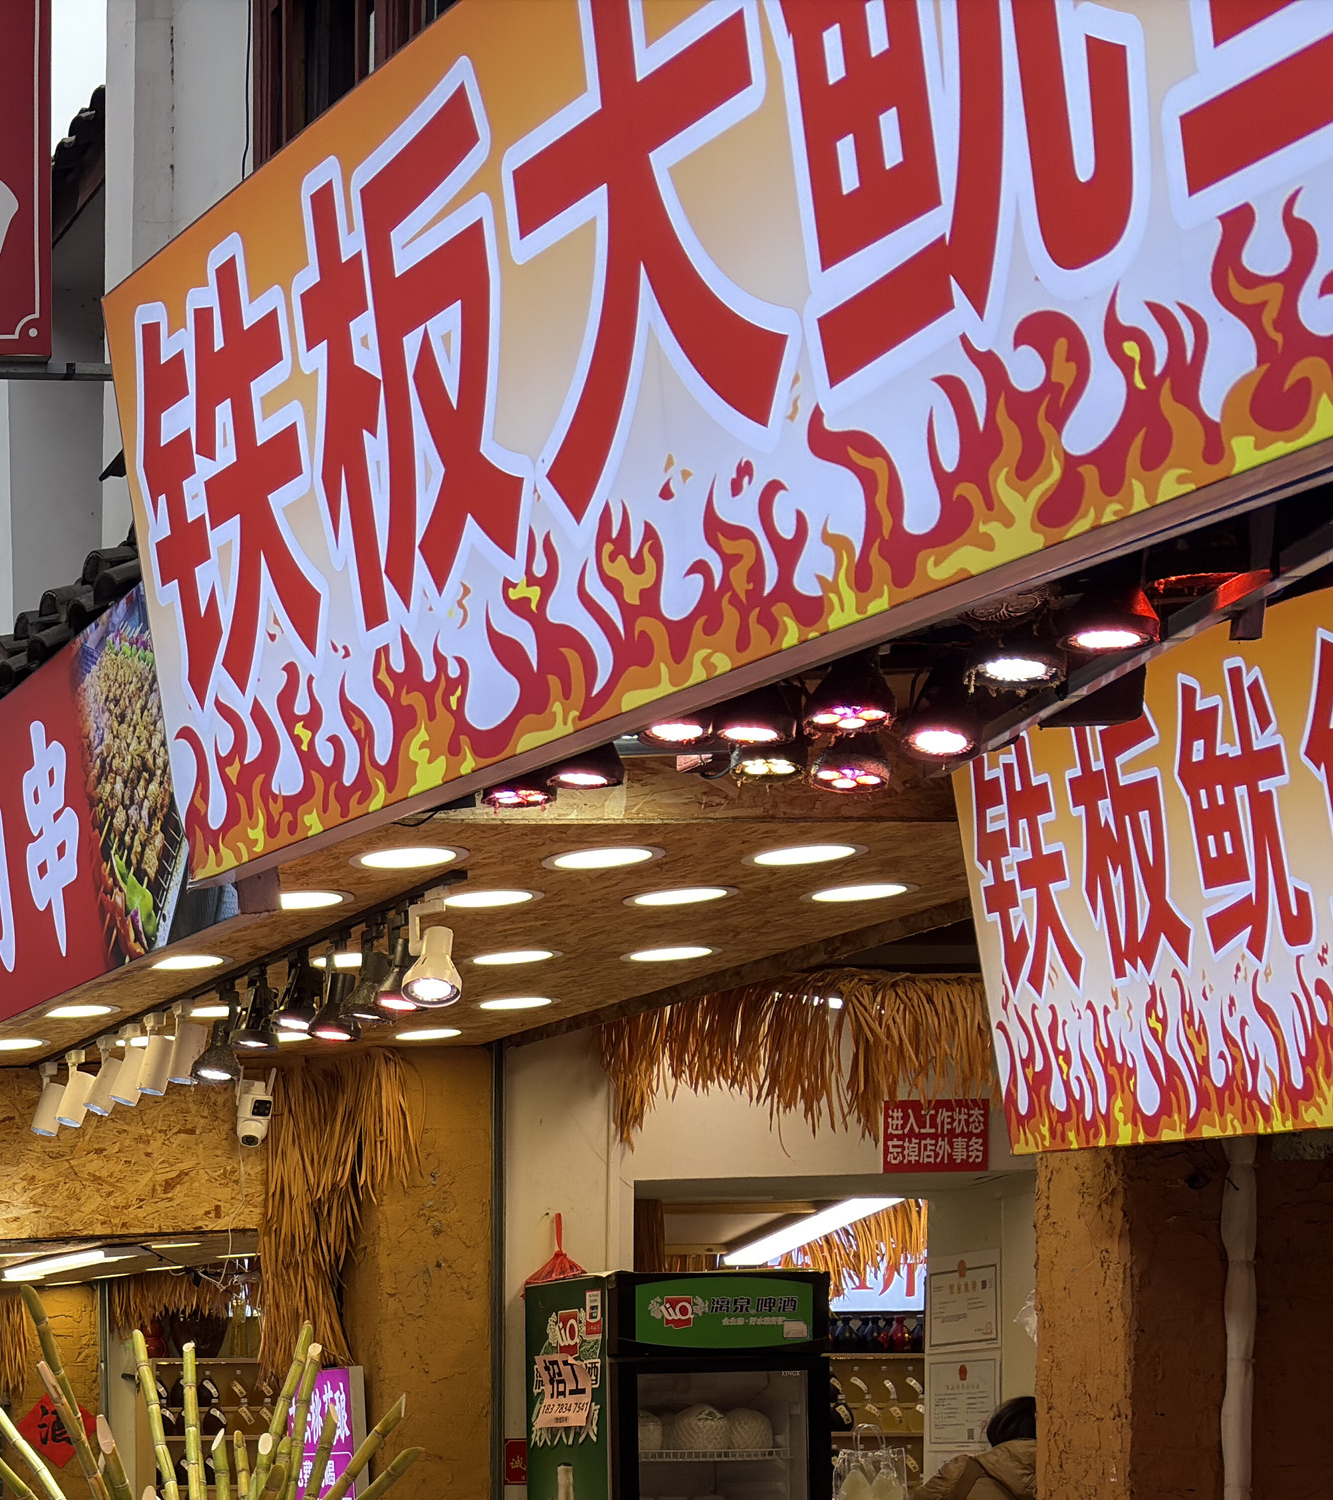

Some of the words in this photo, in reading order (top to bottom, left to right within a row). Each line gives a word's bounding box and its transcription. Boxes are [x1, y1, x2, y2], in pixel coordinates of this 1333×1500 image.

[887, 1108, 984, 1134] 进入工作状态
[887, 1138, 984, 1165] 忘掉店外事务
[709, 1296, 798, 1314] 漓泉啤酒
[544, 1359, 586, 1399] 招工
[542, 1404, 554, 1414] 183
[555, 1403, 571, 1414] 7834
[572, 1401, 589, 1413] 7541
